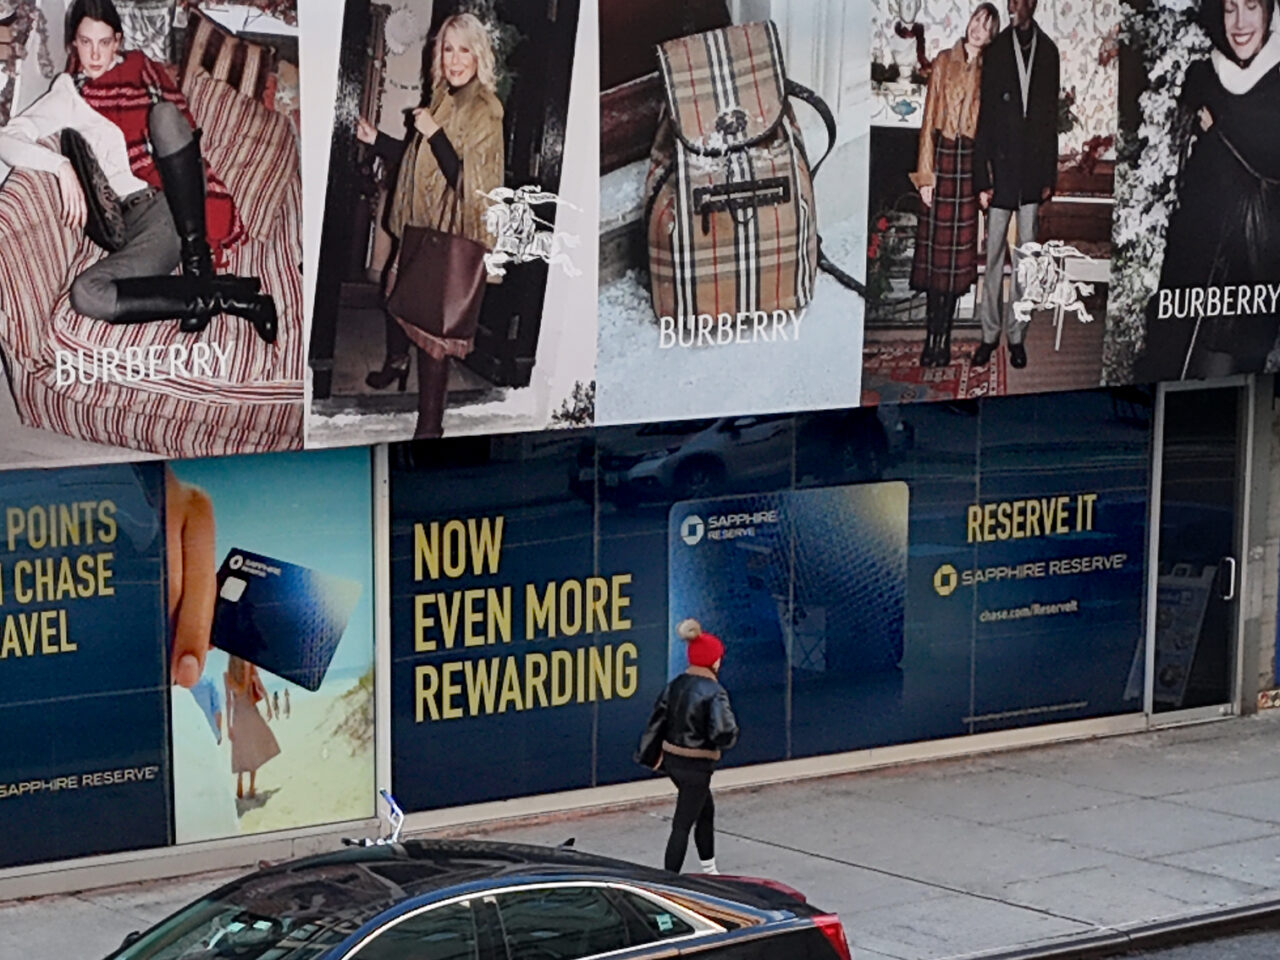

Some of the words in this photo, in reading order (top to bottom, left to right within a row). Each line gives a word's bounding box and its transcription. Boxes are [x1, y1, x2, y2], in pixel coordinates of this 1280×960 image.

[1158, 284, 1280, 319] BURBERRY
[659, 308, 807, 348] BURBERRY
[55, 341, 234, 386] BURBERRY
[6, 499, 117, 551] POINTS
[707, 510, 779, 529] SAPPHIRE
[967, 497, 1070, 543] RESERVE
[1076, 494, 1097, 532] IT
[414, 516, 504, 581] NOW
[14, 552, 115, 604] CHASE
[961, 562, 1045, 585] SAPPHIRE
[414, 586, 512, 653] EVEN
[525, 573, 632, 641] MORE
[414, 642, 638, 723] REWARDING
